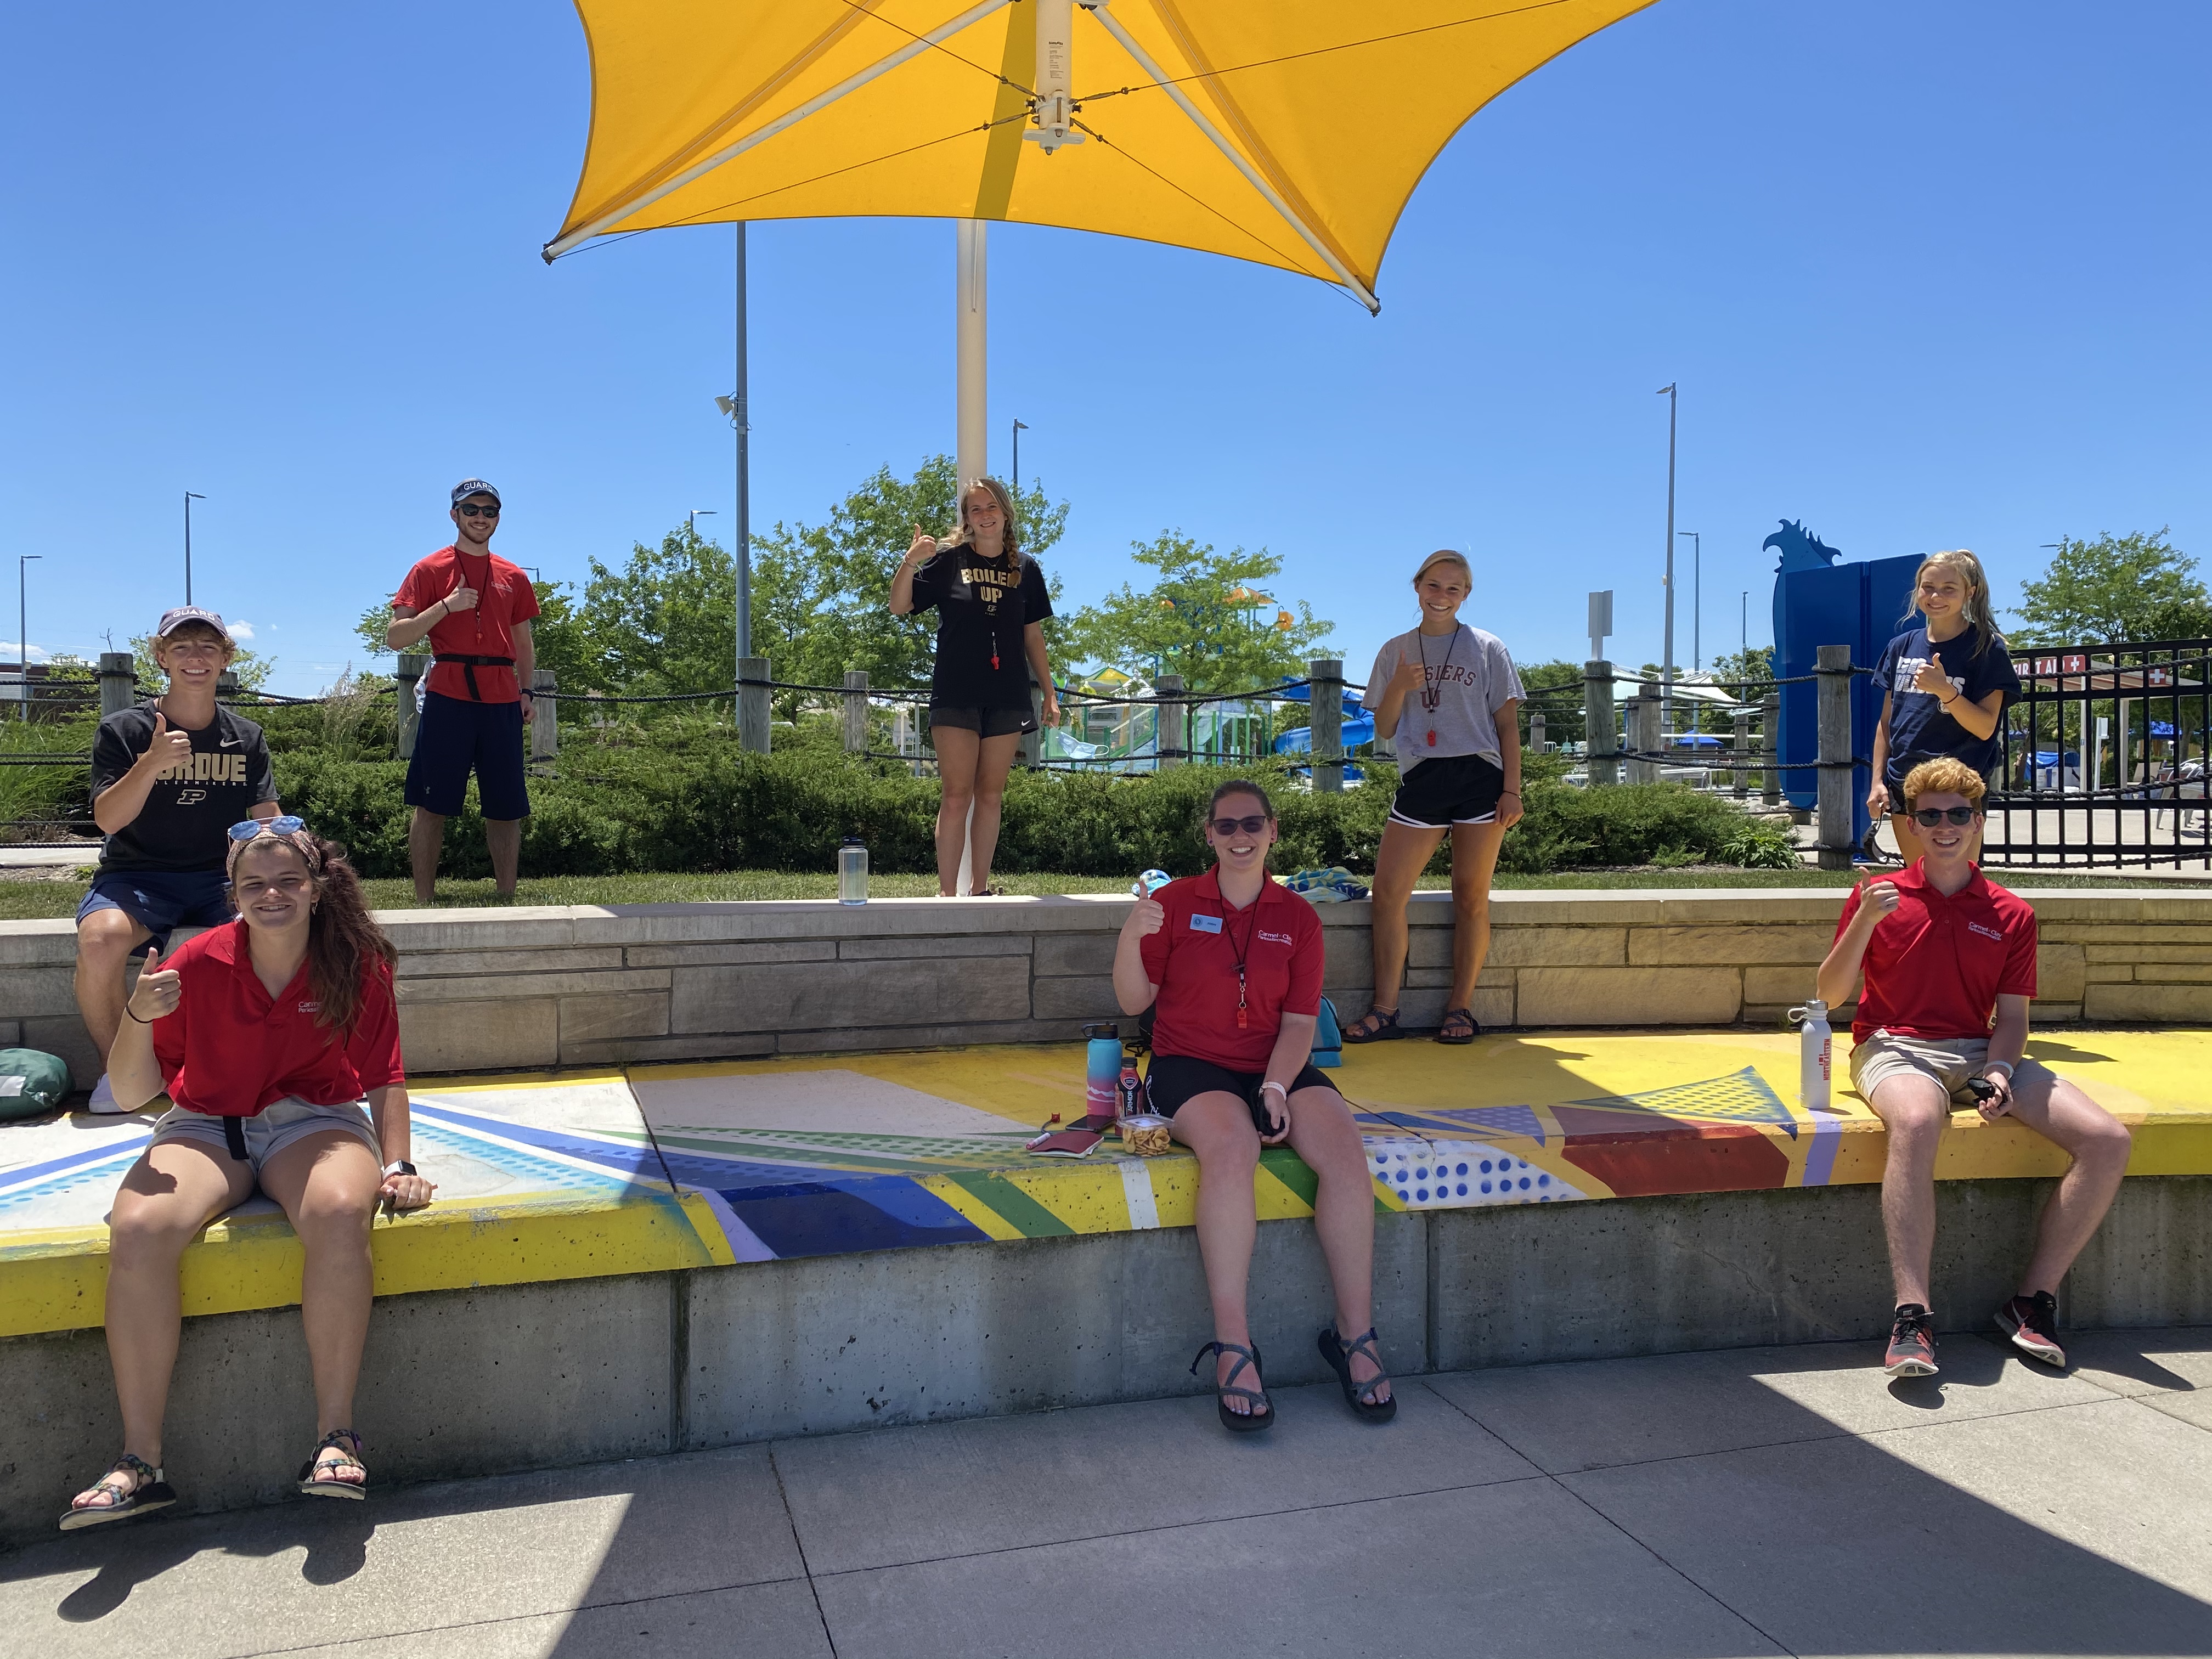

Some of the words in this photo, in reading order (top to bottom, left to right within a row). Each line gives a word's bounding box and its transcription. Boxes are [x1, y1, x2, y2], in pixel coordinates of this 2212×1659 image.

[464, 481, 493, 492] GUARD
[980, 586, 1002, 603] UP
[173, 609, 215, 621] GUARD
[2013, 661, 2042, 675] FIRT
[2045, 658, 2065, 674] AI
[1425, 664, 1477, 687] SIERS
[1969, 922, 1989, 932] Carmel
[1259, 930, 1279, 938] Carmel
[1282, 934, 1293, 942] Clay
